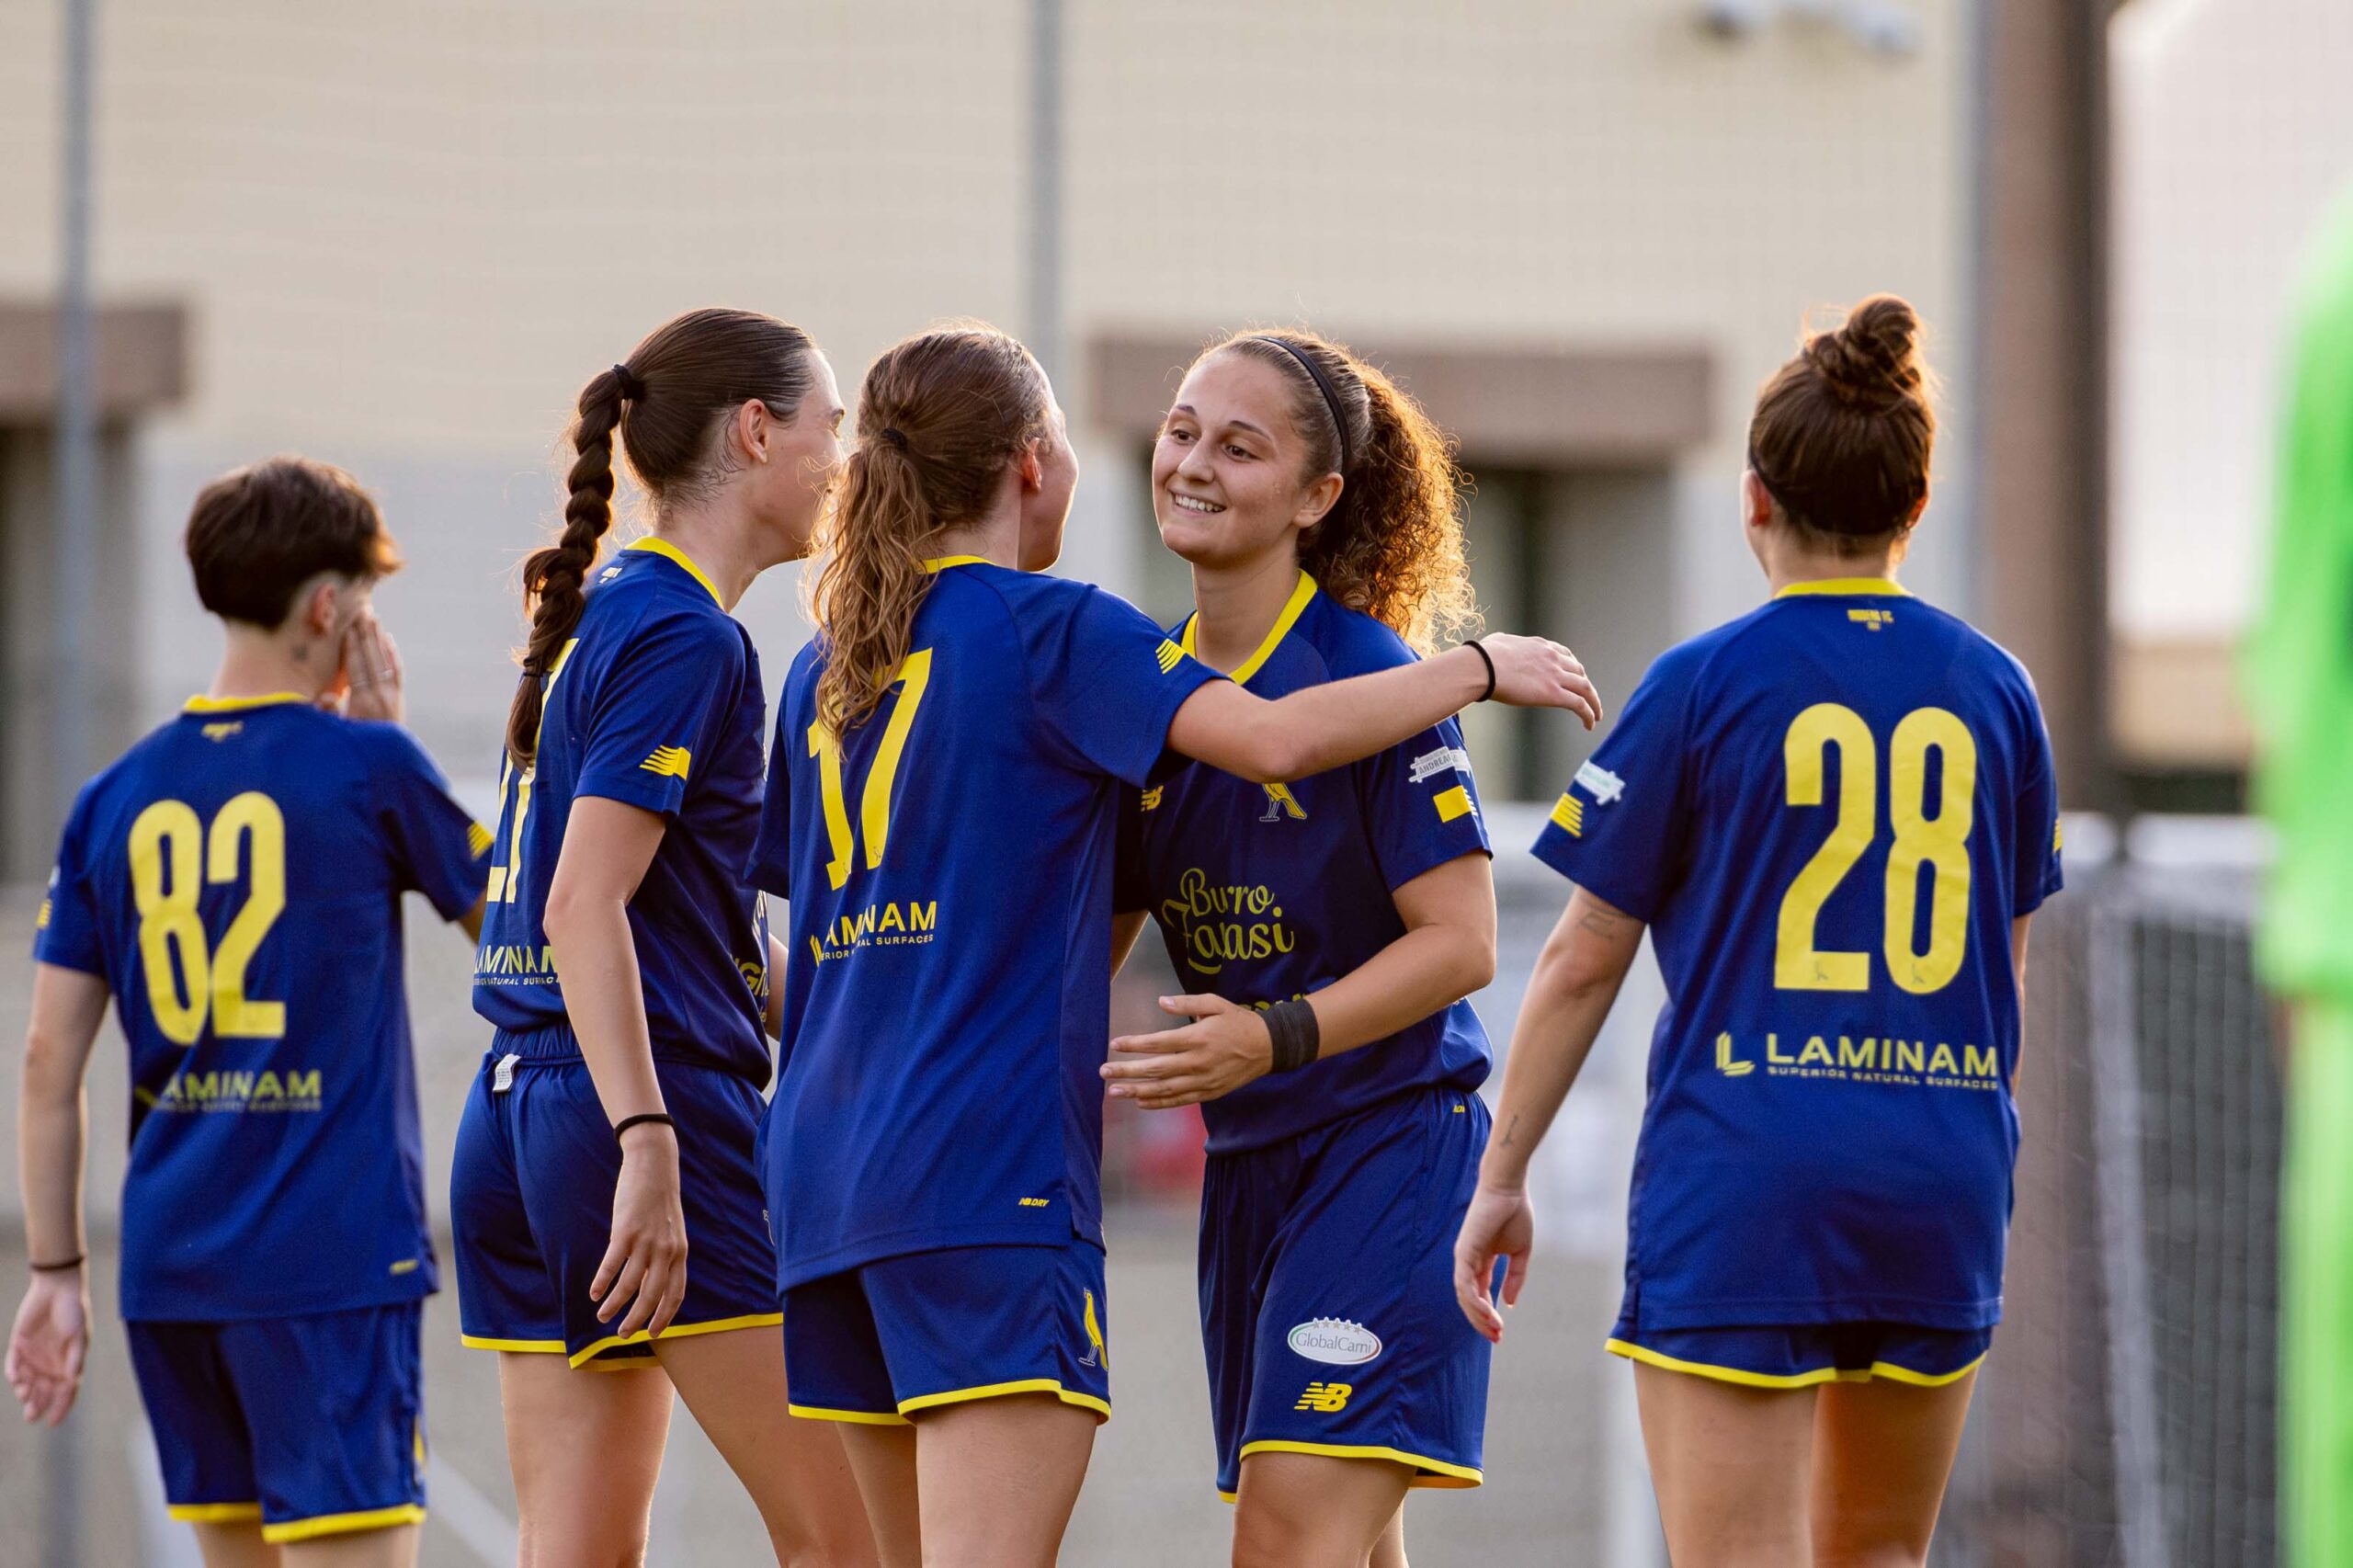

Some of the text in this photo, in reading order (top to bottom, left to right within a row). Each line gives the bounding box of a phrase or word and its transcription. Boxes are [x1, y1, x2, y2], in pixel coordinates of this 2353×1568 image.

[807, 647, 933, 892] 17
[1774, 702, 1977, 994] 28
[129, 791, 286, 1046] 82
[876, 934, 934, 946] SURFACES
[1767, 1032, 1997, 1078] LAMINAM
[1767, 1065, 1999, 1091] SUPERIOR NATURAL SURFACES
[1296, 1332, 1372, 1354] GlobalCarni
